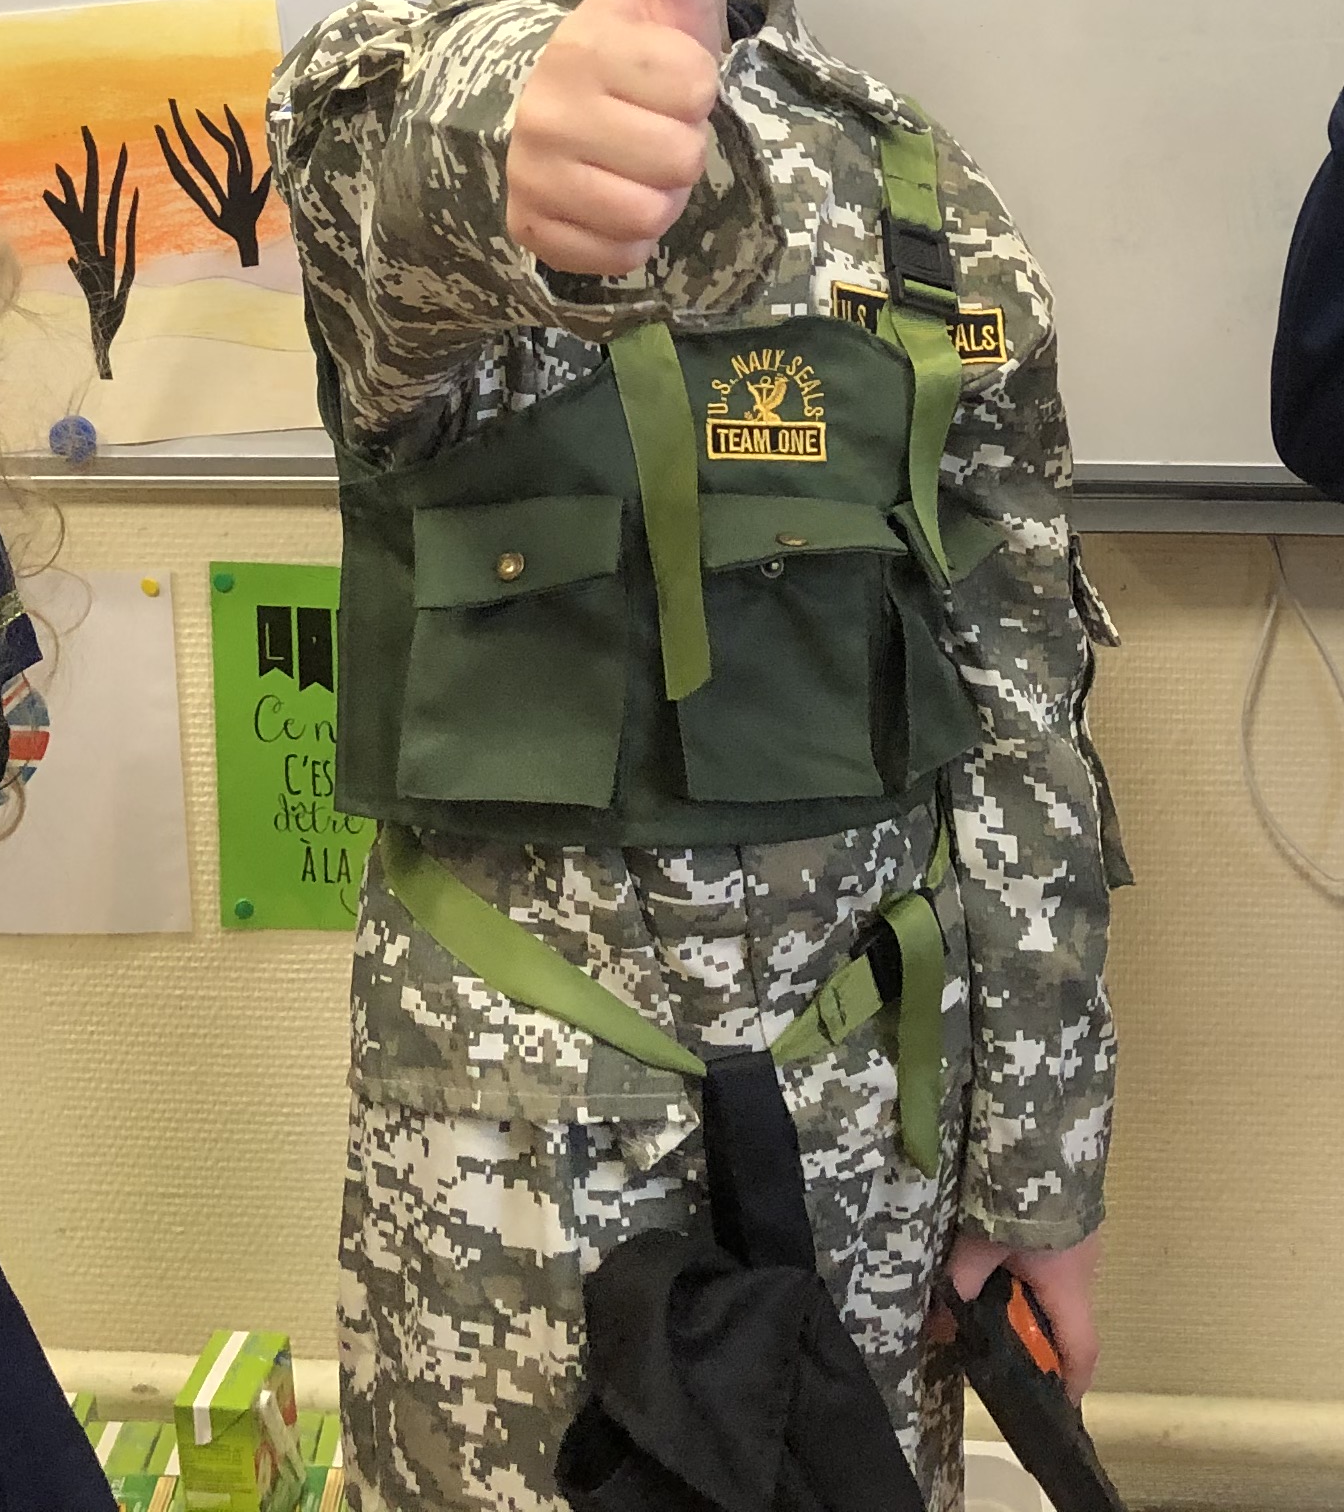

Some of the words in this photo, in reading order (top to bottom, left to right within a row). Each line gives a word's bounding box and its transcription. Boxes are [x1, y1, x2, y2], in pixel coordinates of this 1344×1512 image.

[947, 321, 997, 352] ALS
[730, 348, 786, 379] NAVY
[785, 355, 826, 420] SEALS
[716, 427, 773, 454] TEAM
[777, 429, 819, 454] ONE
[254, 694, 306, 743] Ce
[315, 720, 337, 744] n
[284, 753, 335, 797] C'ES
[323, 847, 351, 884] LA
